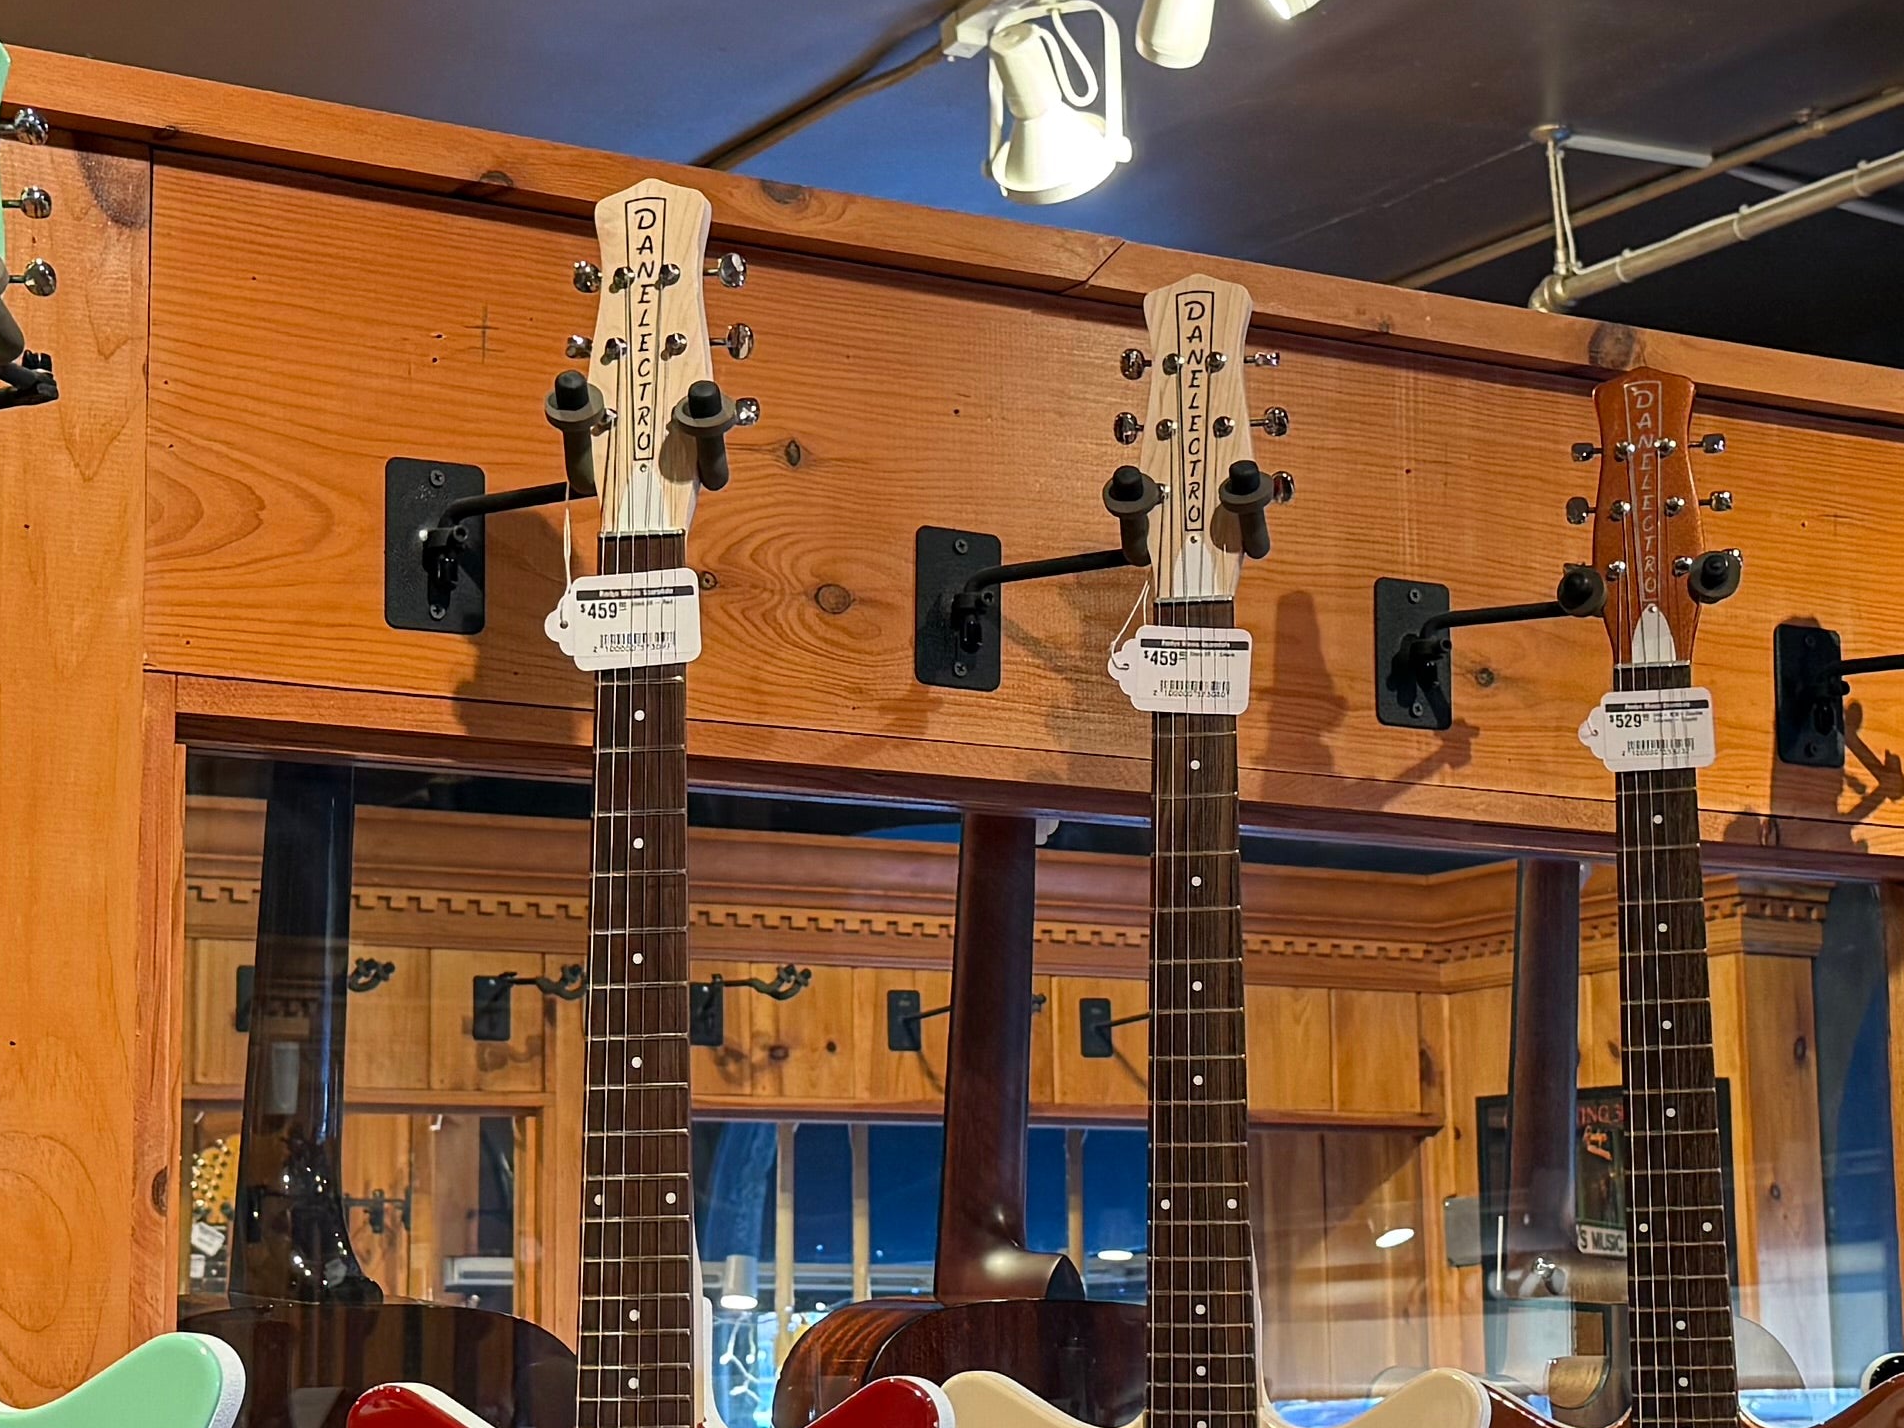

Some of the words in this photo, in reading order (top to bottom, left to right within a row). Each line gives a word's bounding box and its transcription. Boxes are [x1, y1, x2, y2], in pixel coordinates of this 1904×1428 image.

[634, 207, 657, 454] DANELECTRO
[1184, 300, 1207, 524] DANELECTRO
[1633, 389, 1657, 594] DANELECTRO
[580, 602, 618, 620] $459
[1143, 650, 1178, 666] $459
[1609, 713, 1642, 728] $529
